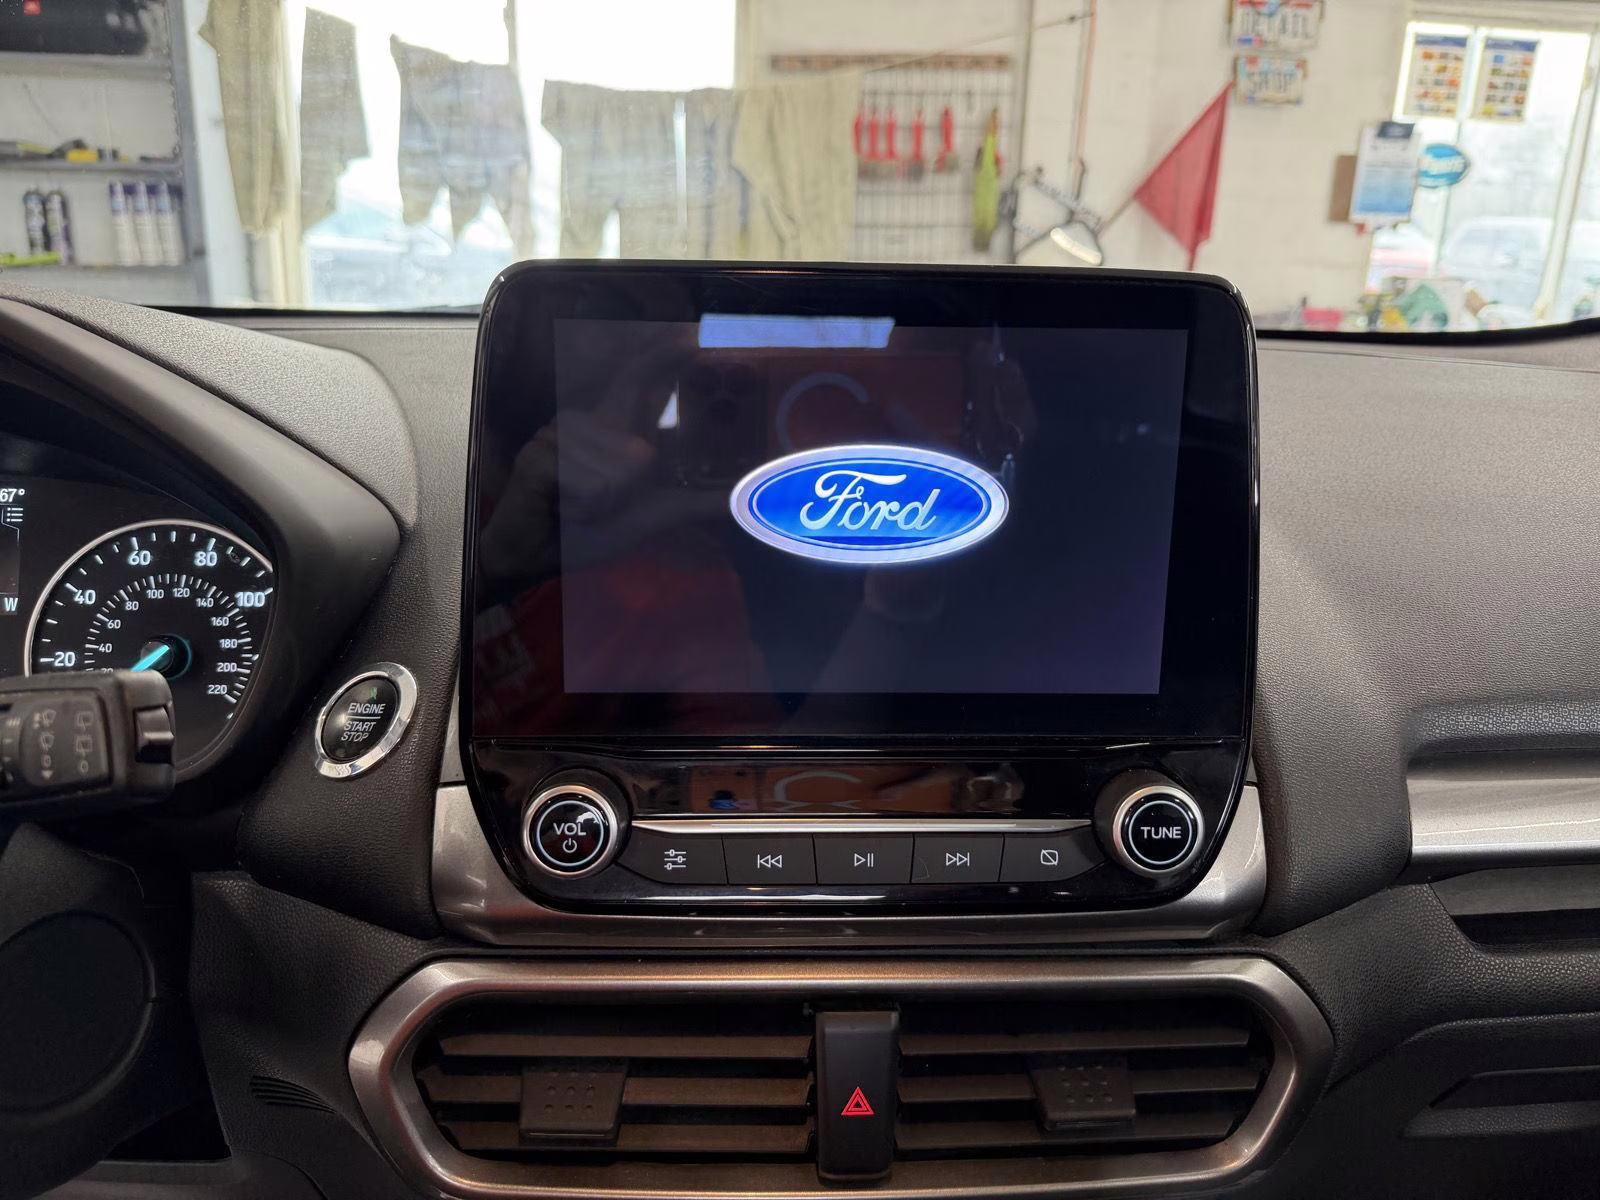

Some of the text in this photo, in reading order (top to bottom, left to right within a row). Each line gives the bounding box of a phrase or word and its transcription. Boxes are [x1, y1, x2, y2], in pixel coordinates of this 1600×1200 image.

[799, 469, 941, 531] Ford
[128, 550, 151, 566] 60
[194, 551, 218, 567] 80
[74, 589, 97, 605] 40
[146, 589, 165, 599] 100
[172, 587, 190, 598] 120
[196, 598, 214, 608] 140
[235, 591, 265, 608] 100
[125, 601, 139, 611] 80
[107, 619, 121, 629] 60
[211, 616, 229, 626] 160
[99, 643, 112, 653] 40
[219, 638, 238, 649] 180
[54, 651, 76, 667] 20
[217, 662, 237, 673] 200
[208, 684, 228, 695] 220
[348, 702, 386, 714] ENGINE
[344, 721, 376, 732] START
[341, 731, 370, 742] STOP
[552, 822, 587, 836] VOL
[1140, 826, 1182, 839] TUNE
